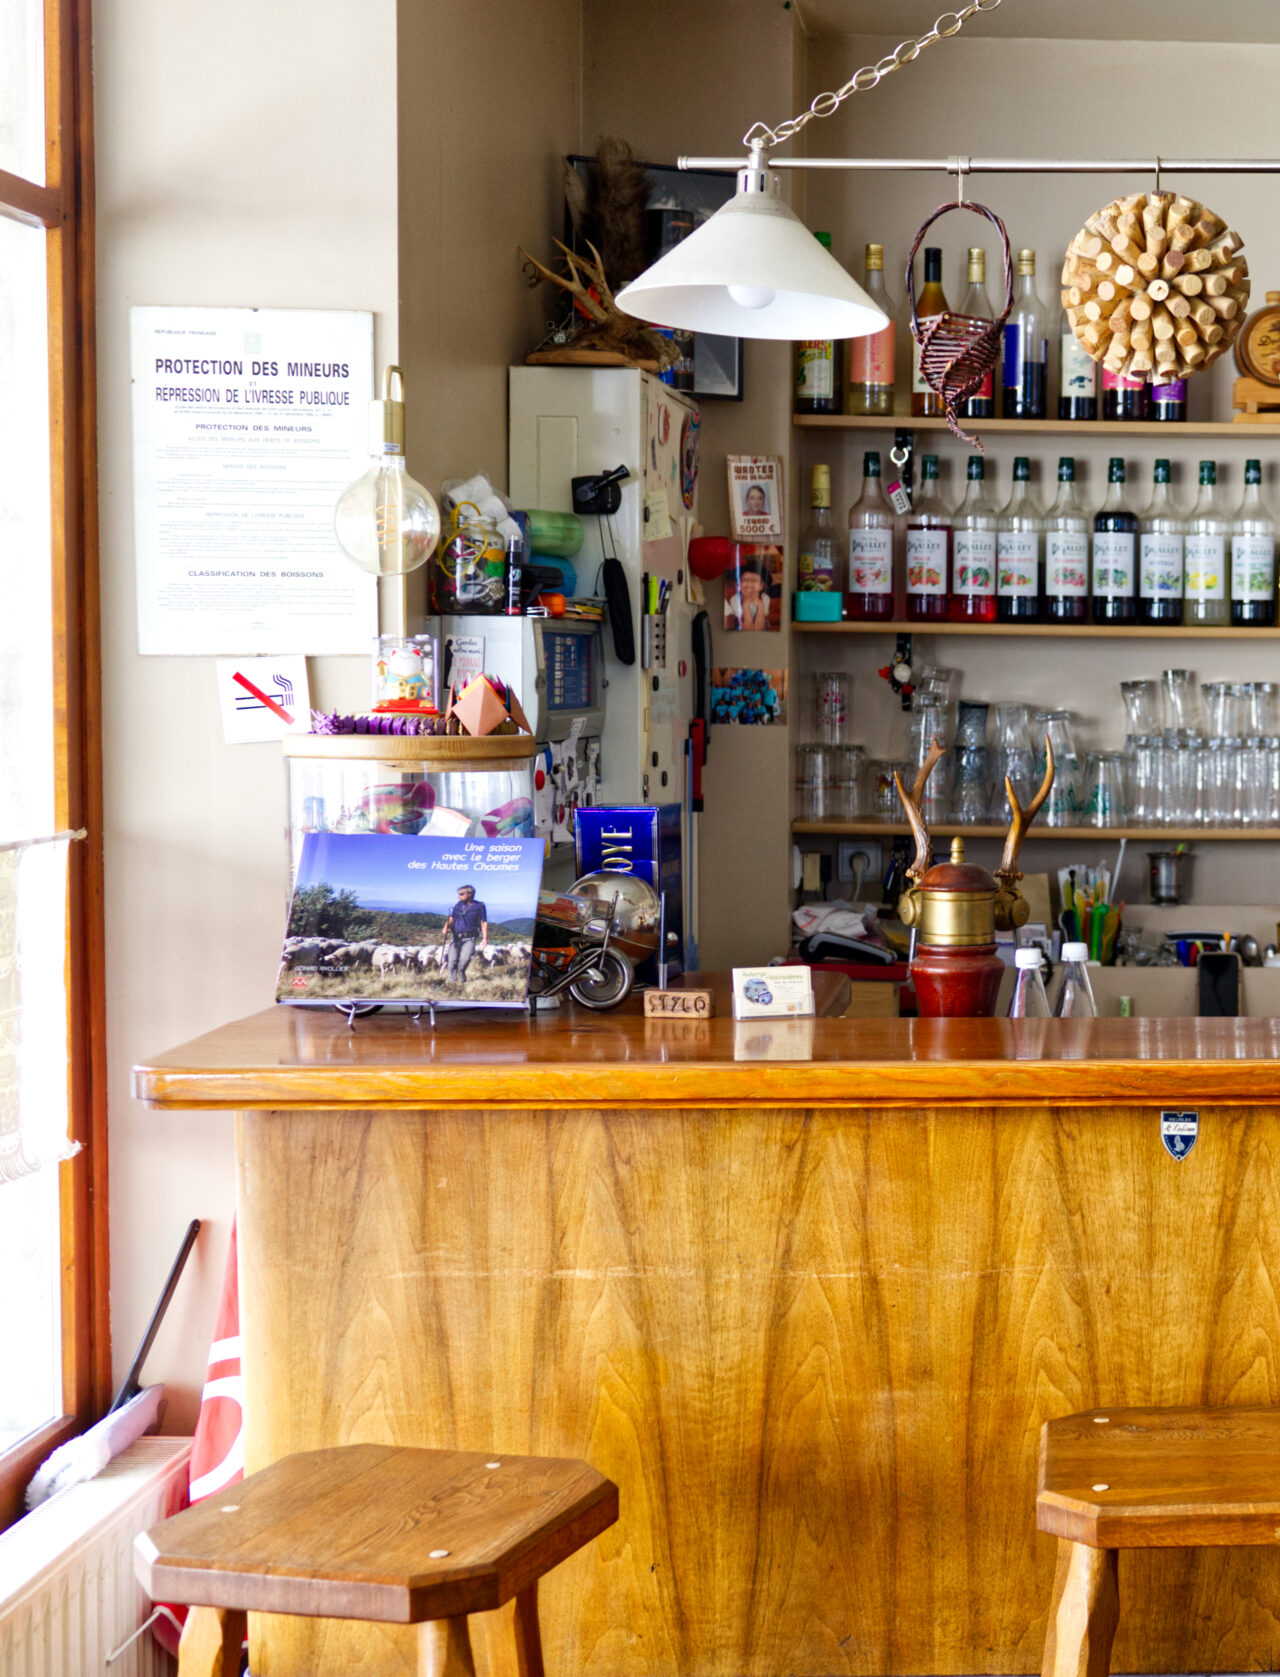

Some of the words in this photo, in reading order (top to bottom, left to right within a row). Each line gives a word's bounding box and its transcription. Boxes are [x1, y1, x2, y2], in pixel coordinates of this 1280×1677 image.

[155, 358, 244, 376] PROTECTION
[251, 361, 279, 377] DES
[287, 362, 350, 378] MINEURS
[155, 384, 220, 403] RÉPRESSION
[225, 388, 239, 403] DE
[244, 389, 294, 405] L'IVRESSE
[299, 391, 350, 406] PUBLIQUE
[195, 423, 249, 431] PROTECTION
[734, 465, 774, 474] WANTED
[740, 525, 766, 533] 5000
[188, 570, 256, 578] CLASSIFICATION
[464, 842, 485, 853] Une
[489, 844, 522, 853] saison
[441, 853, 466, 862] avec
[470, 852, 482, 861] le
[486, 853, 521, 864] berger
[407, 860, 427, 870] des
[431, 861, 469, 871] Hautes
[473, 862, 520, 871] Chaumes
[648, 995, 706, 1013] STYLO
